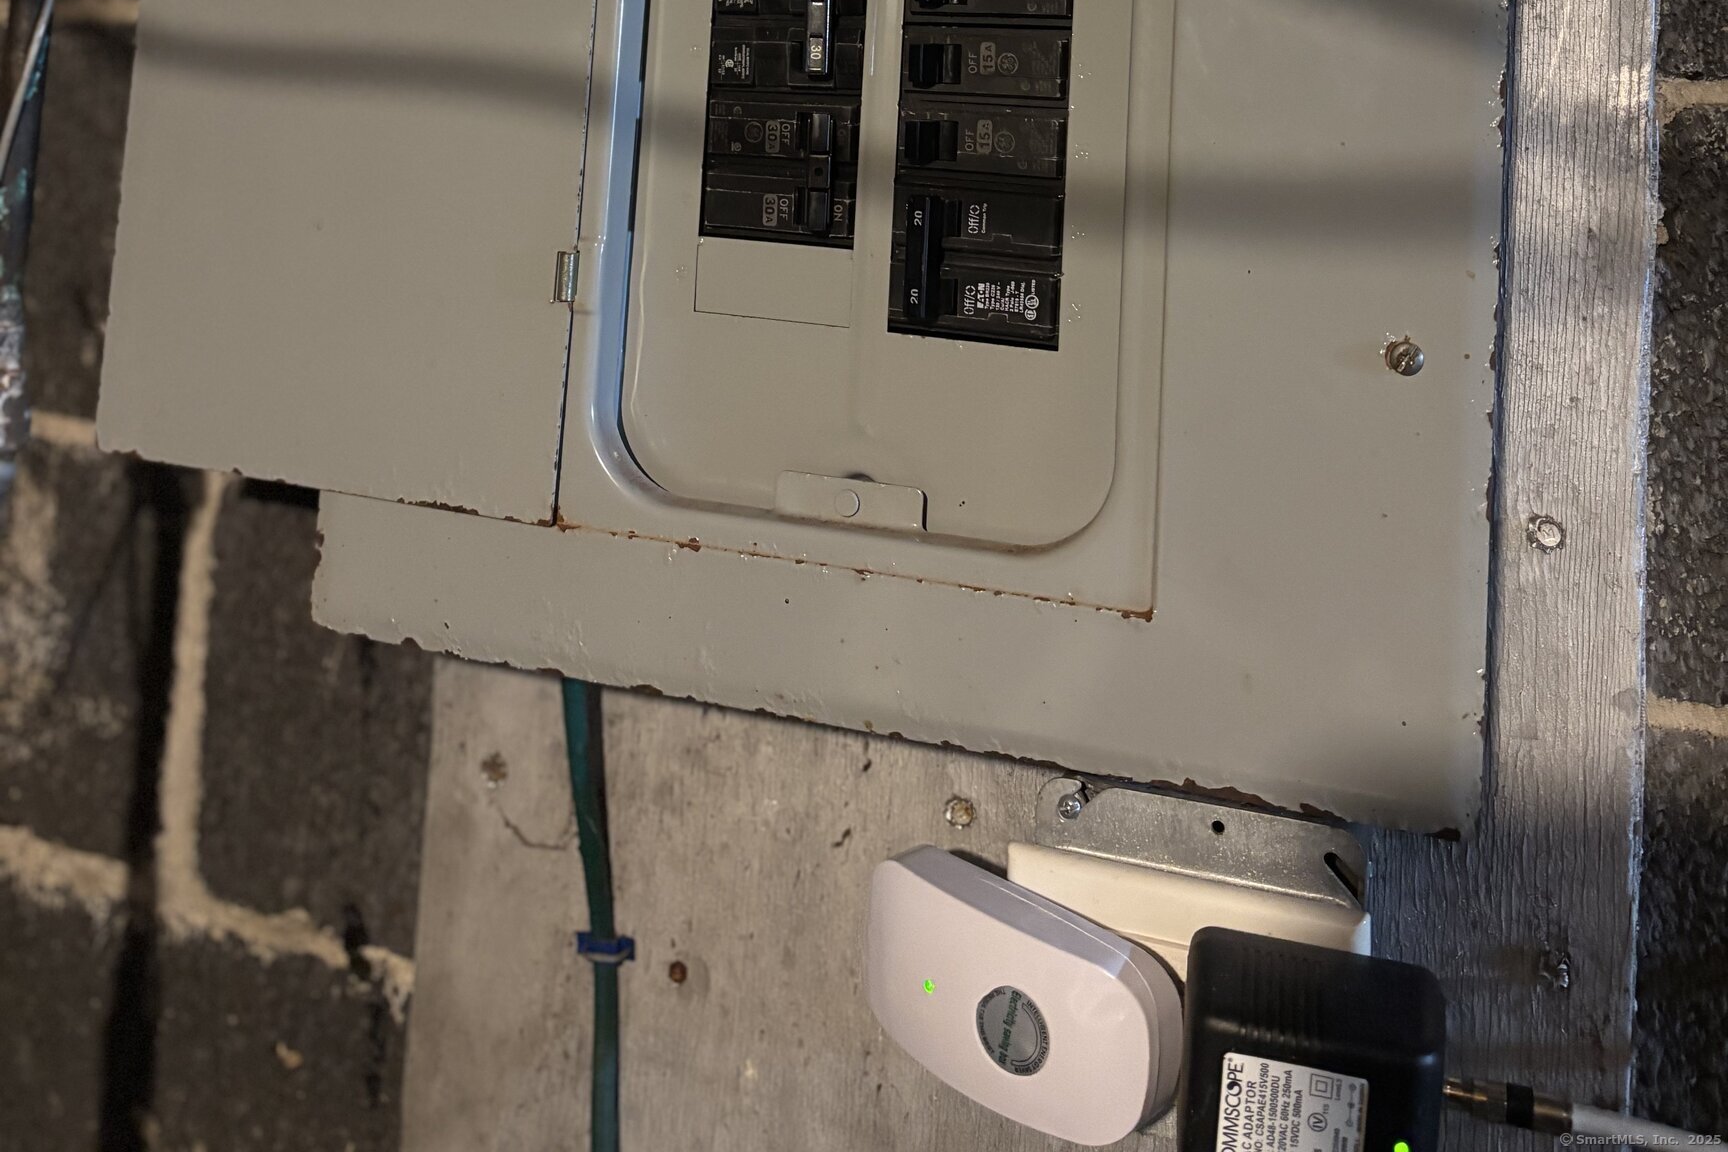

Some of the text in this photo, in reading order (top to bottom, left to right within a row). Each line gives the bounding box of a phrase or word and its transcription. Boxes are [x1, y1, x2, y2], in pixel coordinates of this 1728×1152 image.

[810, 45, 822, 60] 30
[968, 52, 978, 74] OFF
[982, 44, 994, 72] 15A
[767, 123, 778, 151] 30A
[781, 123, 791, 145] OFF
[965, 129, 975, 152] OFF
[978, 122, 991, 150] 15A
[765, 197, 776, 223] 30A
[780, 198, 789, 221] OFF
[833, 204, 843, 221] ON
[914, 210, 922, 226] 20
[910, 289, 919, 305] 20
[998, 990, 1022, 1065] Electricity saving box
[1283, 1070, 1292, 1098] 250mA
[1244, 1080, 1257, 1139] ADAPTOR
[1255, 1063, 1270, 1135] CSAPAE415V500
[1266, 1075, 1280, 1148] AD48-1500500DU
[1282, 1101, 1291, 1122] 60Hz
[1290, 1090, 1303, 1147] 15VDC 500mA
[1313, 1117, 1323, 1129] IV
